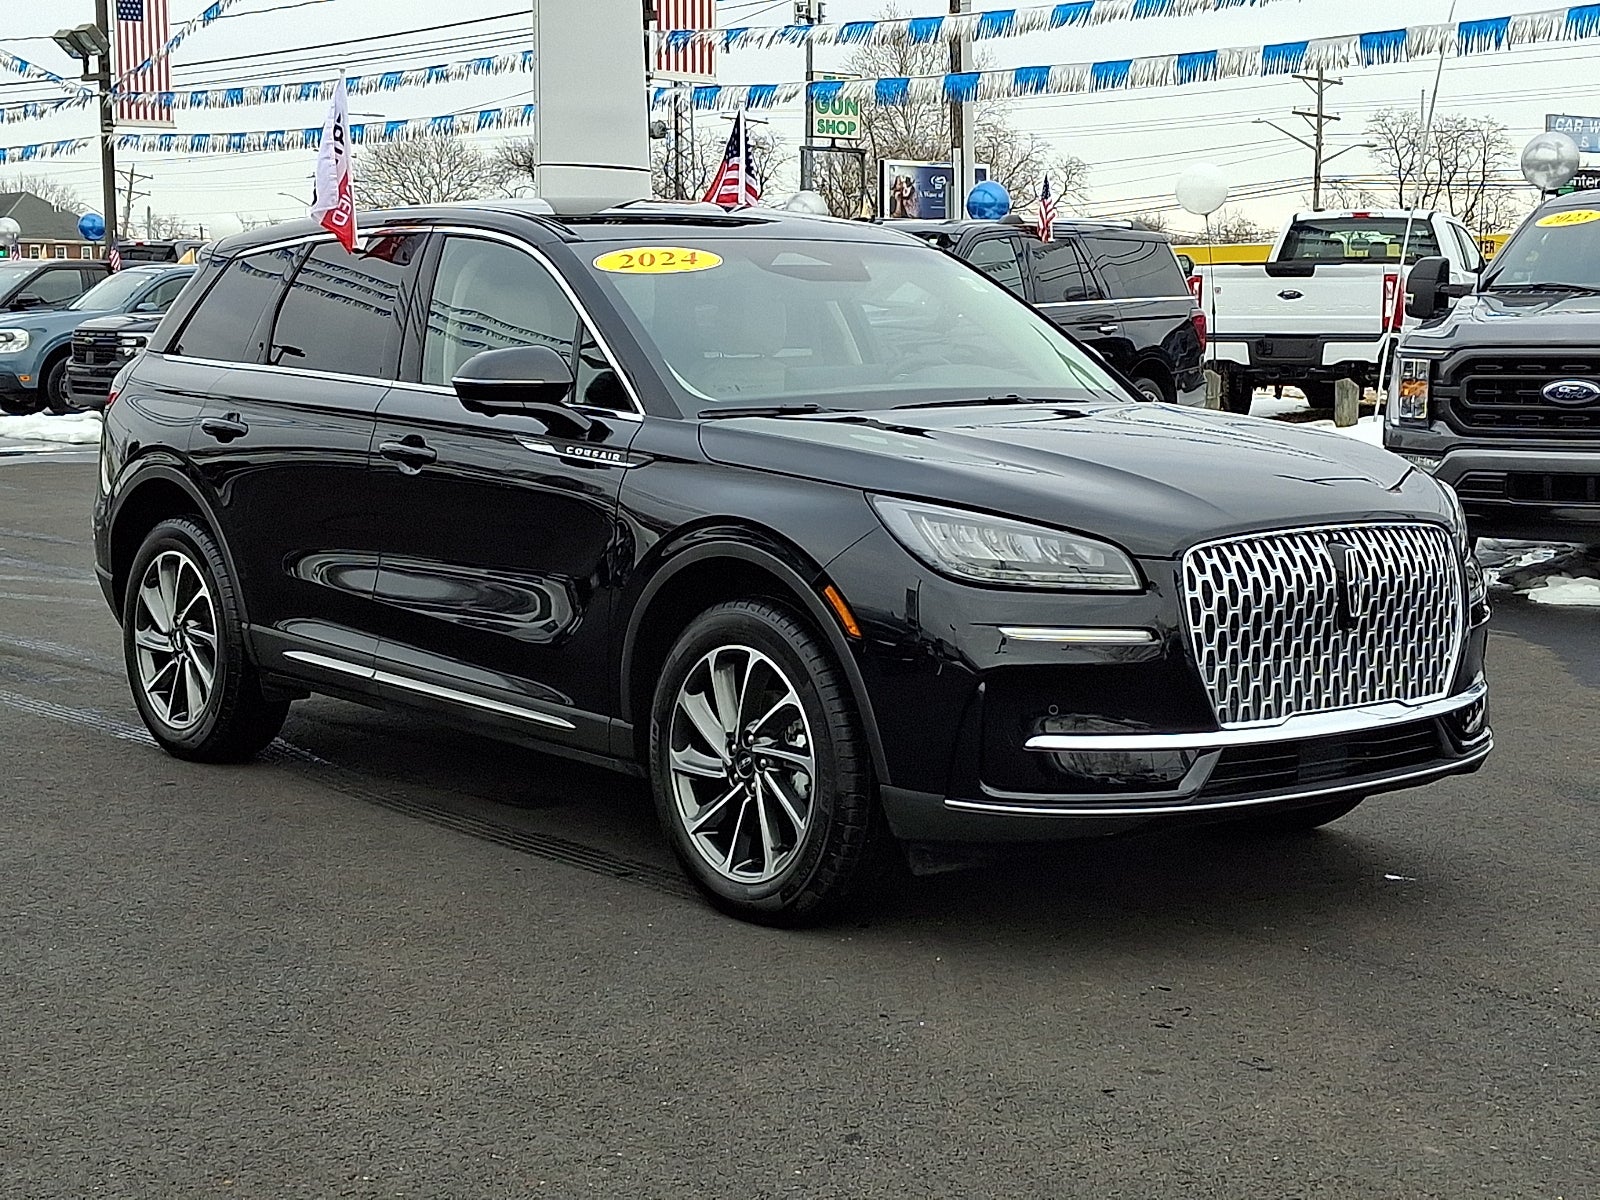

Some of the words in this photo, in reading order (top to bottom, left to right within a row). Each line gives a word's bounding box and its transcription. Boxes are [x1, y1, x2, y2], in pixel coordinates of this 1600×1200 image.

[815, 94, 858, 116] GUN
[817, 119, 856, 135] SHOP
[1555, 118, 1583, 132] CAR
[619, 251, 698, 269] 2024
[1555, 386, 1587, 398] Ford
[565, 446, 621, 461] CORSAIR
